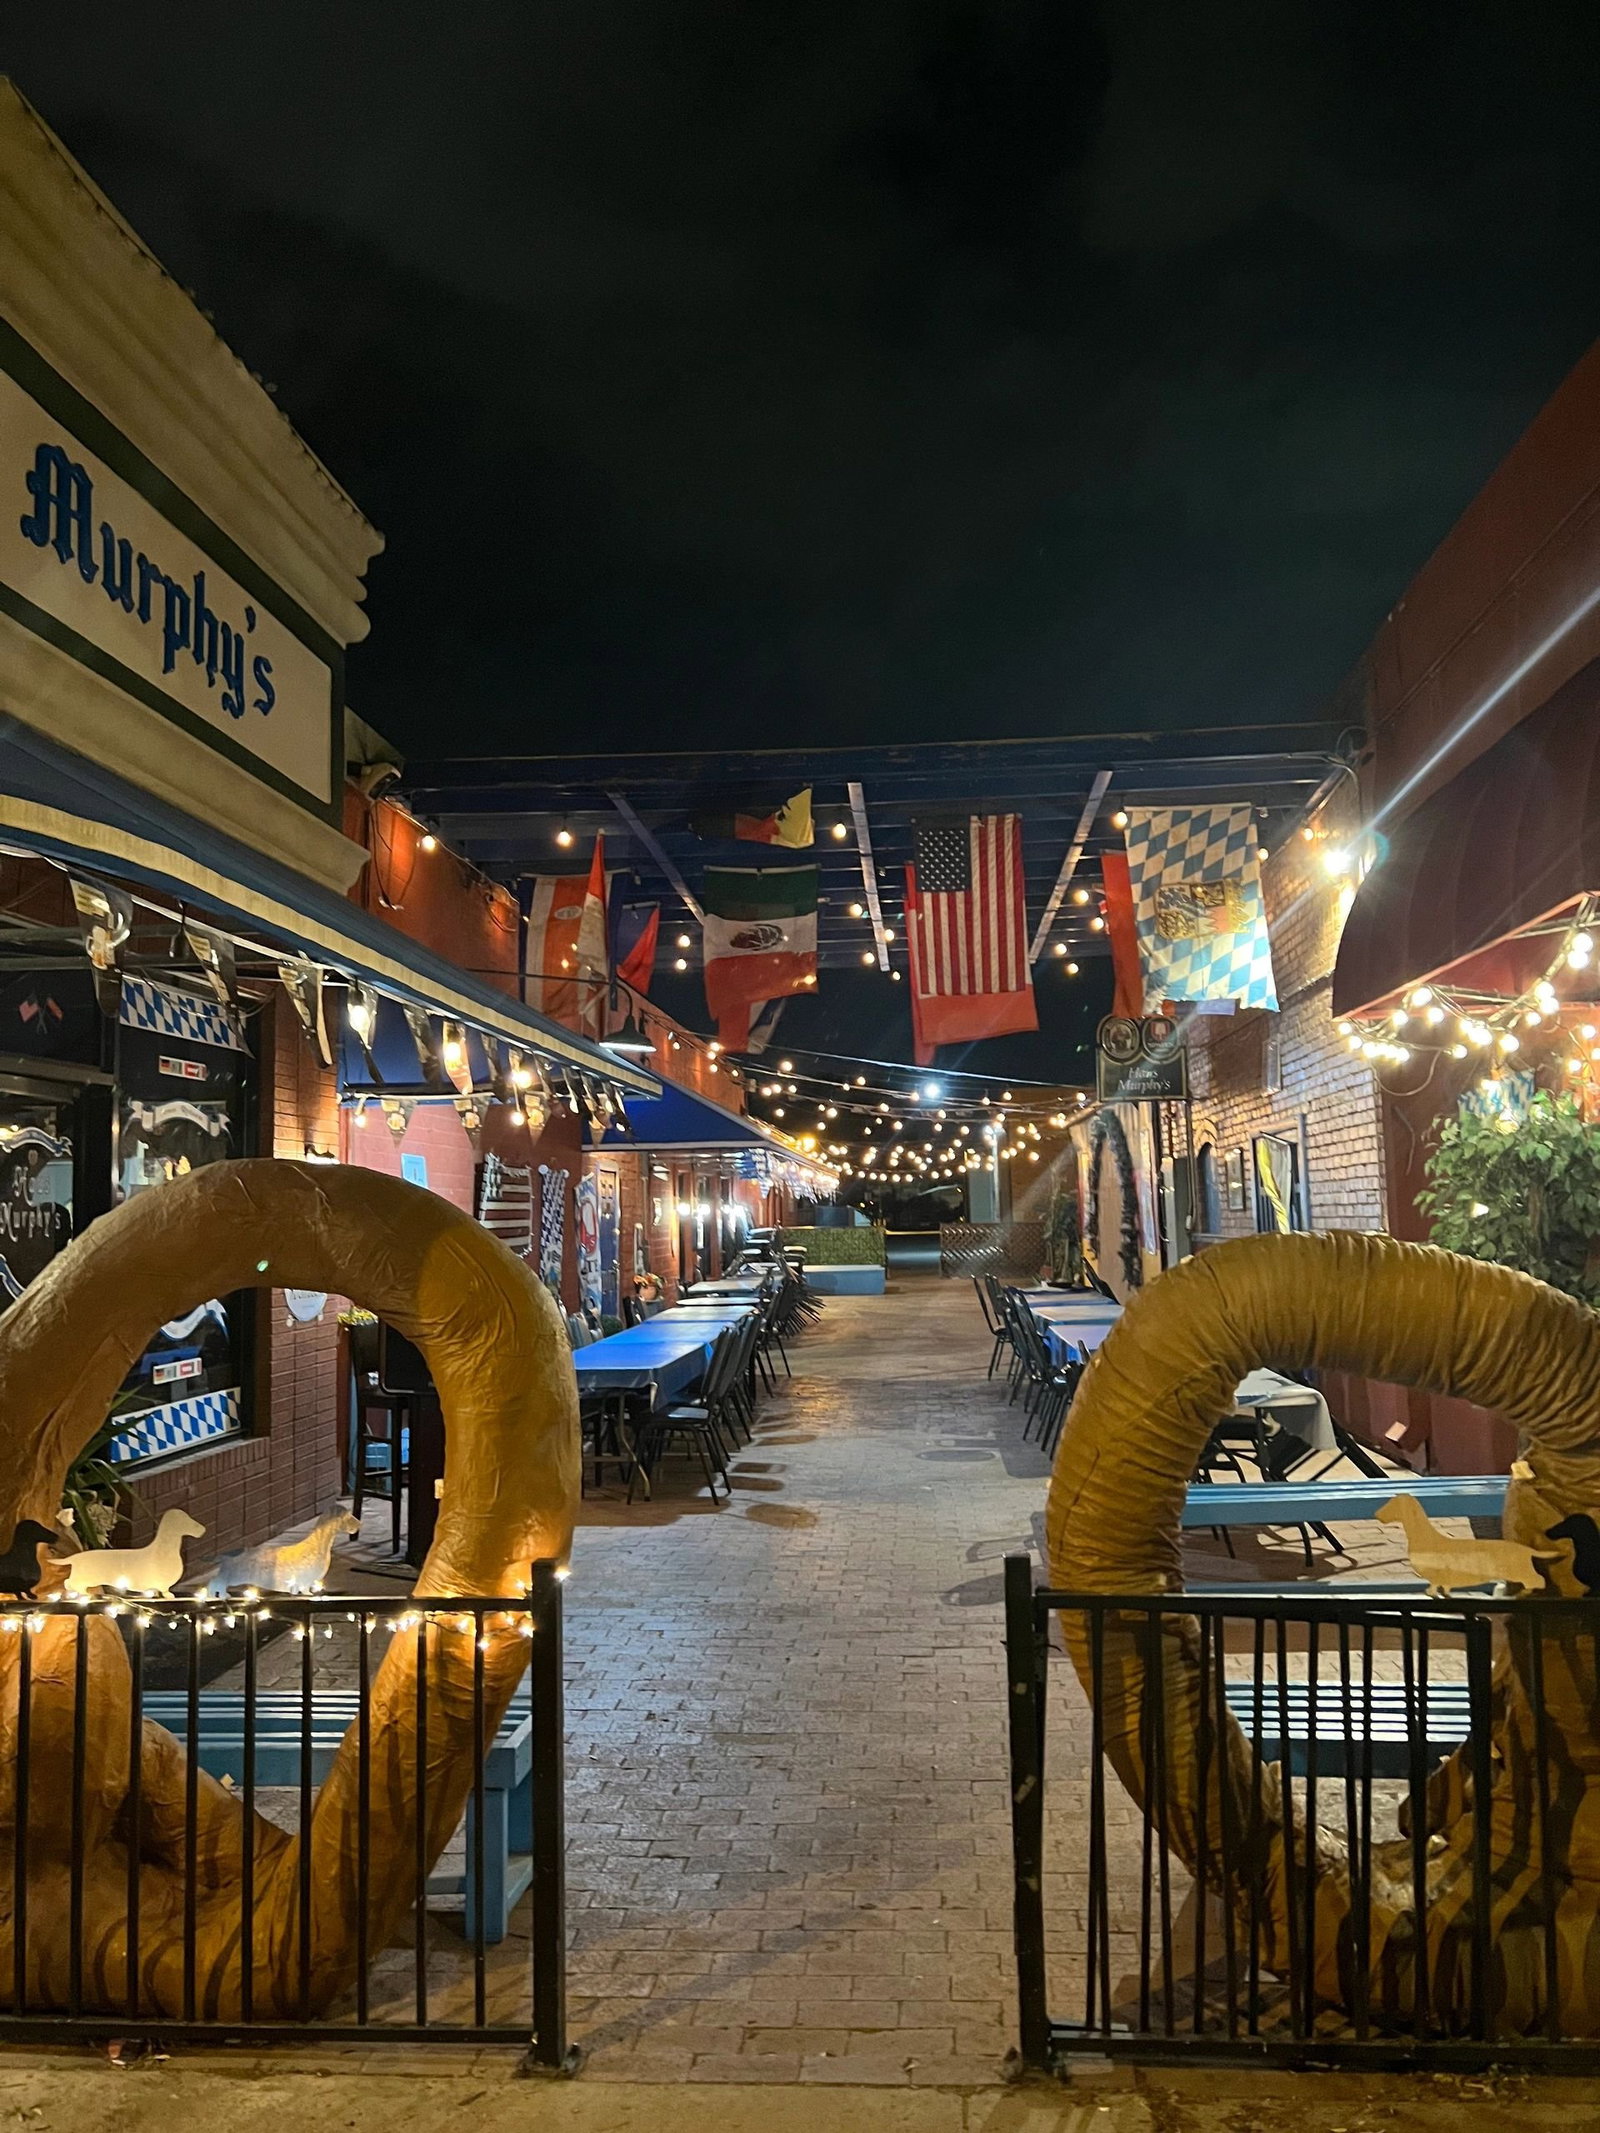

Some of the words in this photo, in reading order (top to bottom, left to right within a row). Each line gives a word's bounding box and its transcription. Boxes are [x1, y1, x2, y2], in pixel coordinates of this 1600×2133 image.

[20, 443, 276, 719] Murphy's
[1128, 1067, 1159, 1079] Hans
[1118, 1079, 1171, 1095] Murphy's
